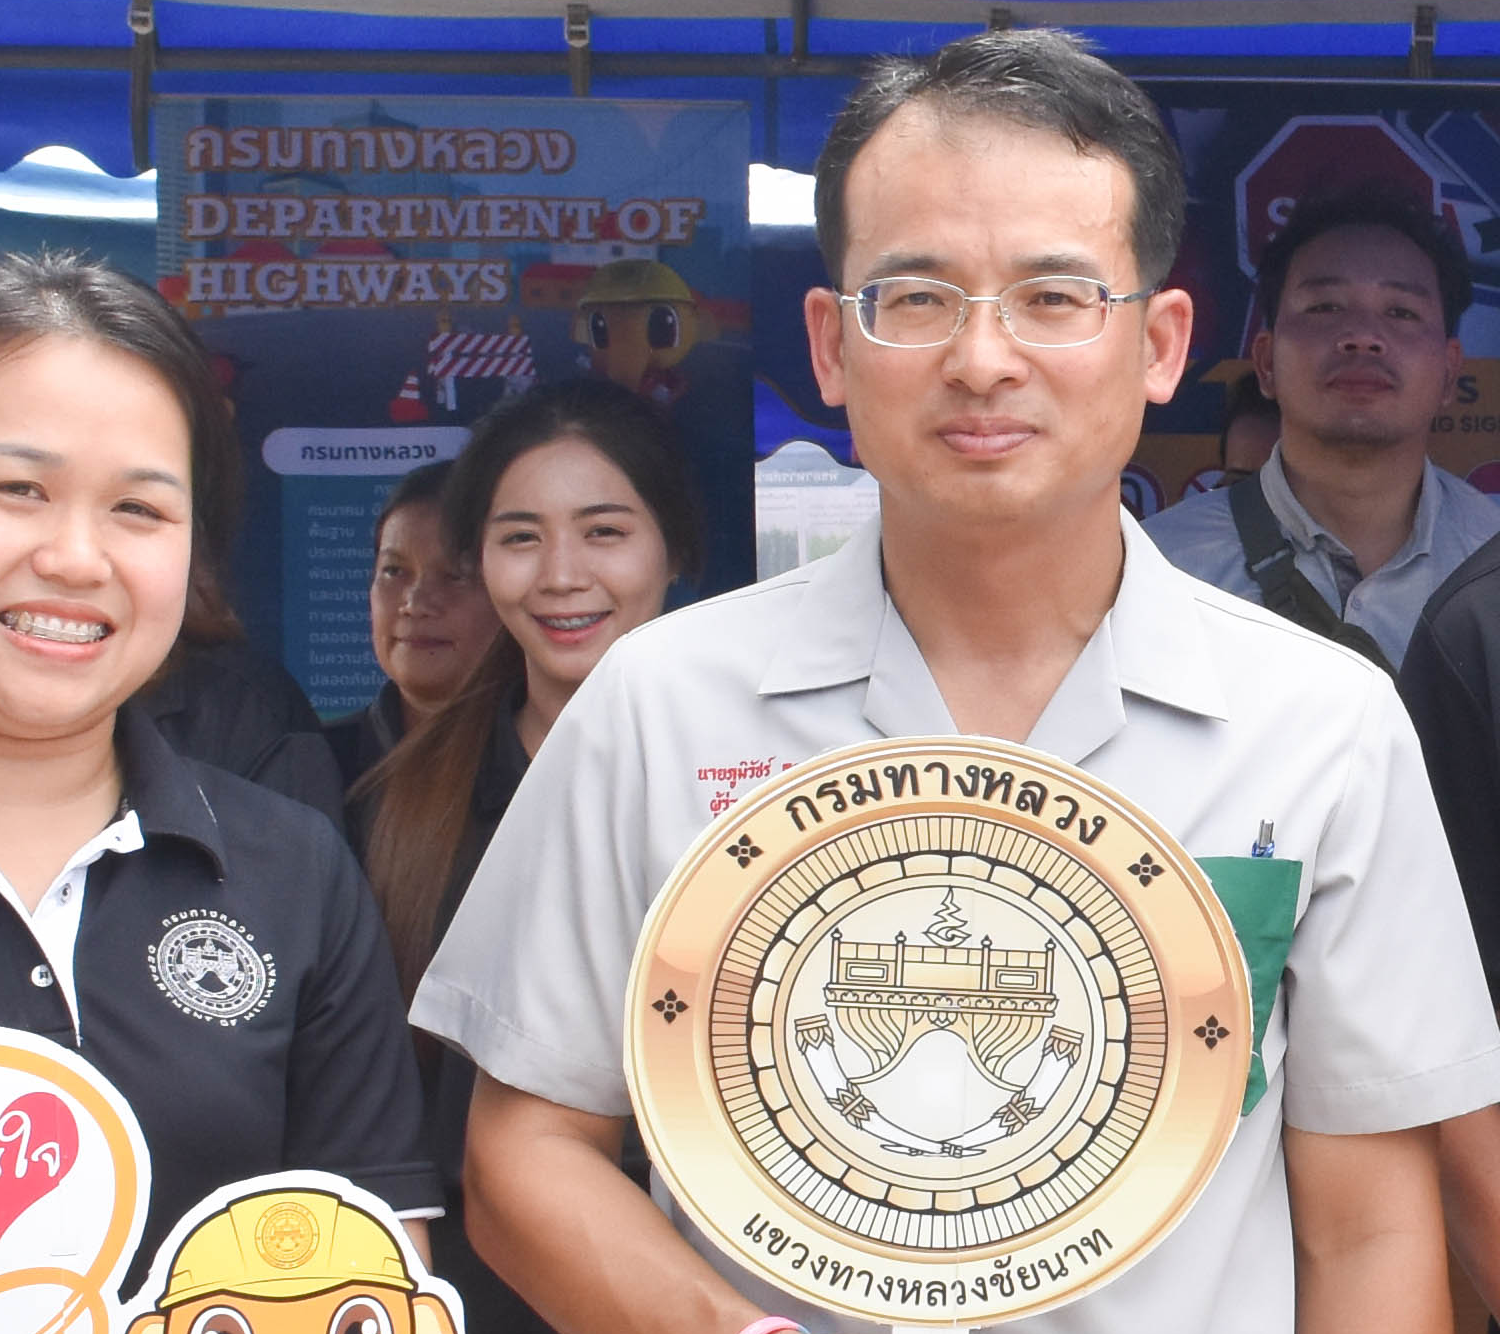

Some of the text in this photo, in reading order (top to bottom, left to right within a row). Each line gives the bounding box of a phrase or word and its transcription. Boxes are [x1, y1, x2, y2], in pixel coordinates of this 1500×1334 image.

[188, 128, 575, 174] กรมทางหลวง
[186, 196, 702, 245] DEPARTMENT OF
[186, 261, 509, 303] HIGHWAYS
[301, 443, 437, 460] กรมทางหลวง
[786, 761, 1107, 845] กรมทางหลวง
[742, 1210, 1113, 1307] แขวงทางหลวงชัยนาท
